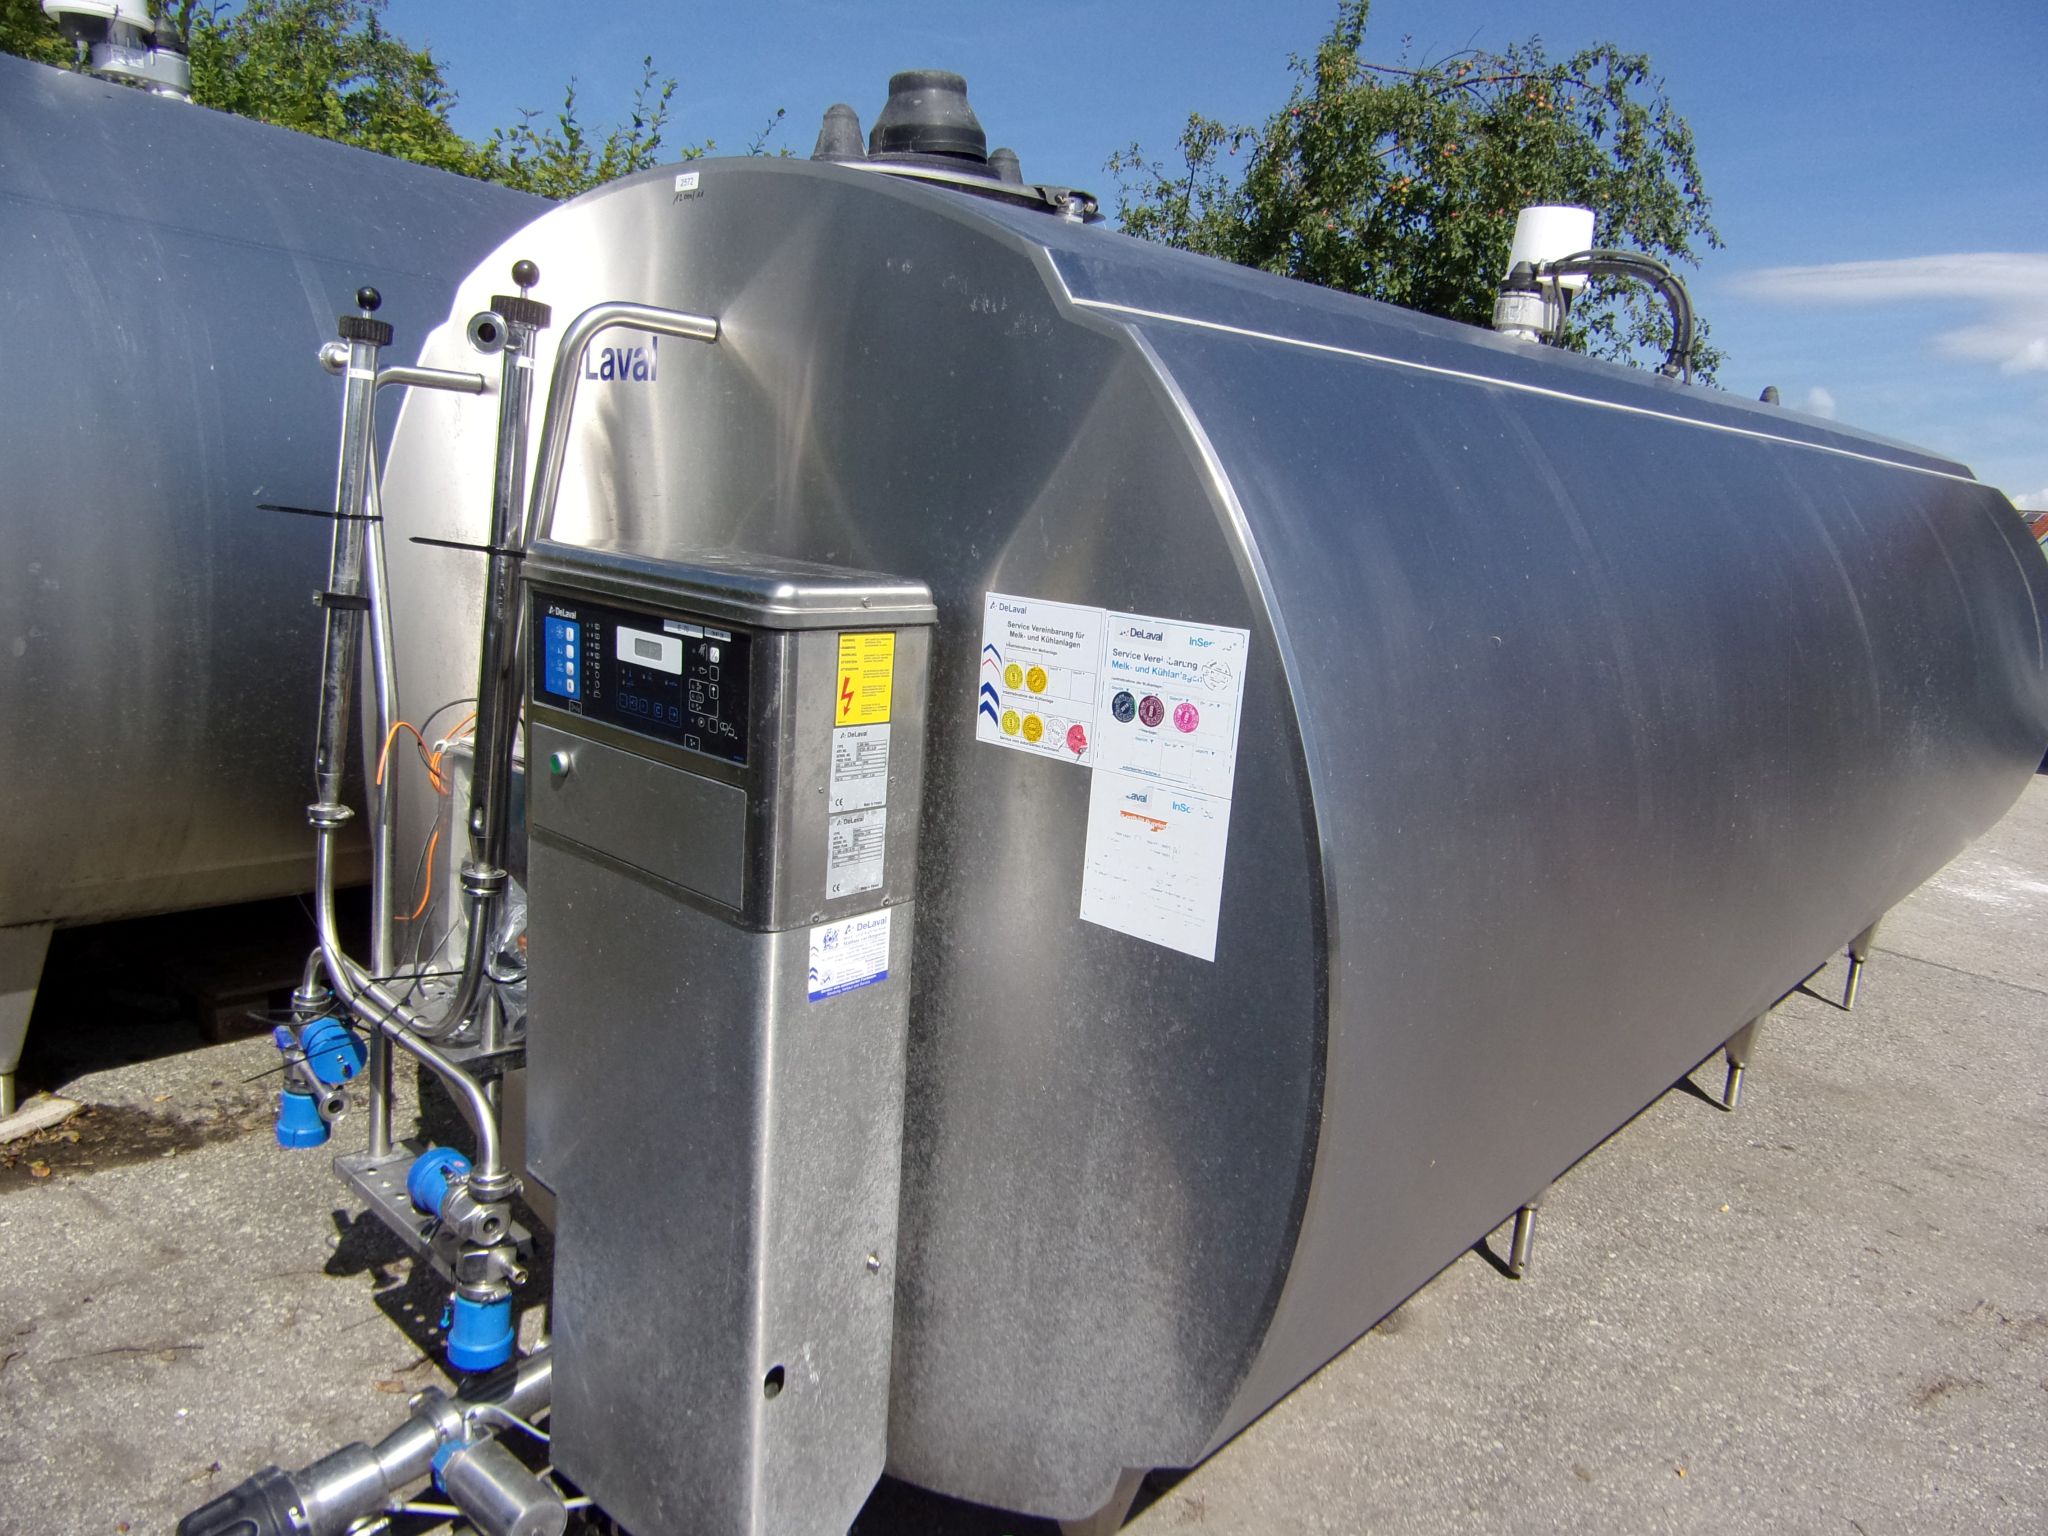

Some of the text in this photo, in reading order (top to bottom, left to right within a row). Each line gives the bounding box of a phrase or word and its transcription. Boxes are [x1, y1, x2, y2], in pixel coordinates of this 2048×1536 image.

[555, 606, 577, 620] DeLaval
[999, 602, 1028, 615] DeLaval
[1007, 620, 1085, 640] Service Vereinbarung für
[1130, 627, 1164, 642] DeLaval
[1009, 630, 1081, 649] Melk- und Kühlanlagen
[1112, 648, 1142, 660] Service
[1111, 659, 1134, 671] Melk-
[1134, 665, 1150, 674] und
[856, 916, 888, 931] DeLaval
